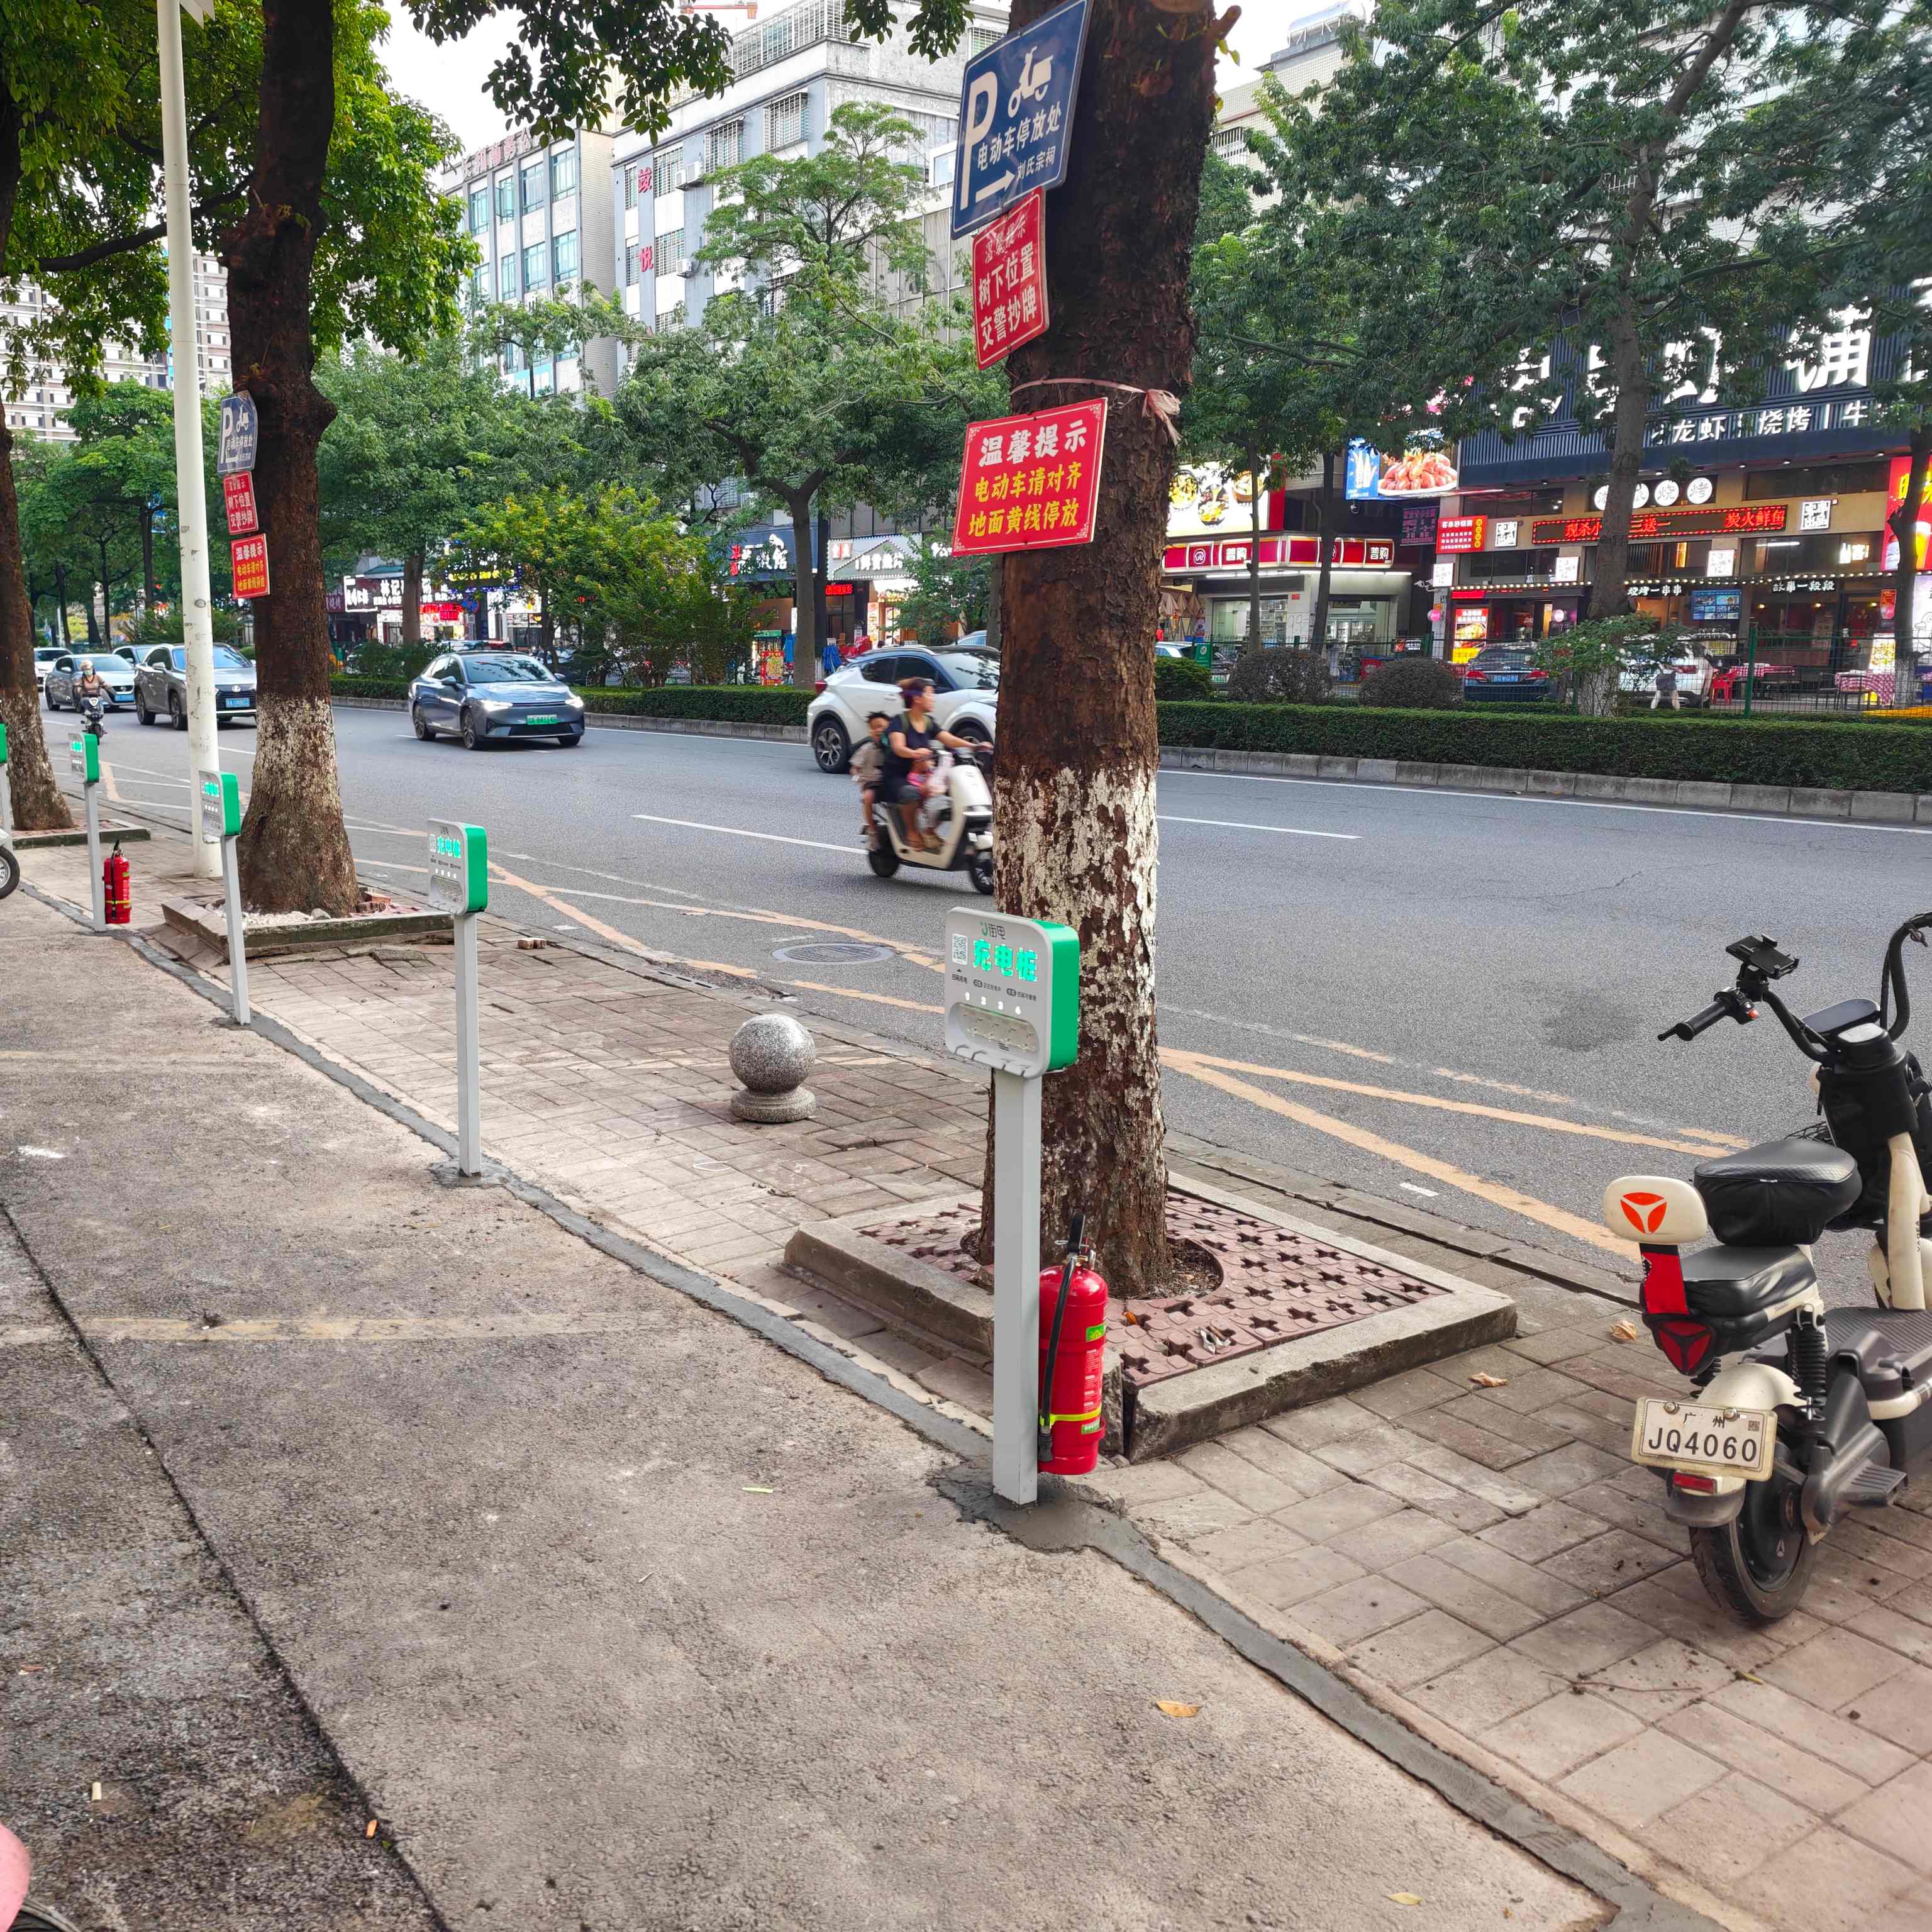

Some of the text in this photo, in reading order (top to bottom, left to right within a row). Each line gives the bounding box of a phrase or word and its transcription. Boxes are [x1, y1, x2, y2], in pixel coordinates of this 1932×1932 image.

[960, 70, 998, 210] P
[977, 101, 1062, 172] 电动车停放处
[1017, 145, 1056, 182] 刘氏宗祠
[979, 244, 1035, 311] 树下位置
[981, 287, 1036, 351] 交警抄牌
[221, 408, 233, 464] P
[1759, 406, 1813, 435] 烧烤
[979, 419, 1087, 467] 温馨提示
[975, 462, 1082, 502] 电动车请对齐
[968, 497, 1079, 538] 地面黄线停放
[1725, 509, 1786, 530] 炭火鲜鱼
[1773, 580, 1835, 593] 故事一段段
[973, 938, 1038, 982] 充电柜
[1683, 1412, 1726, 1428] 广州
[1648, 1428, 1757, 1462] JQ4060
